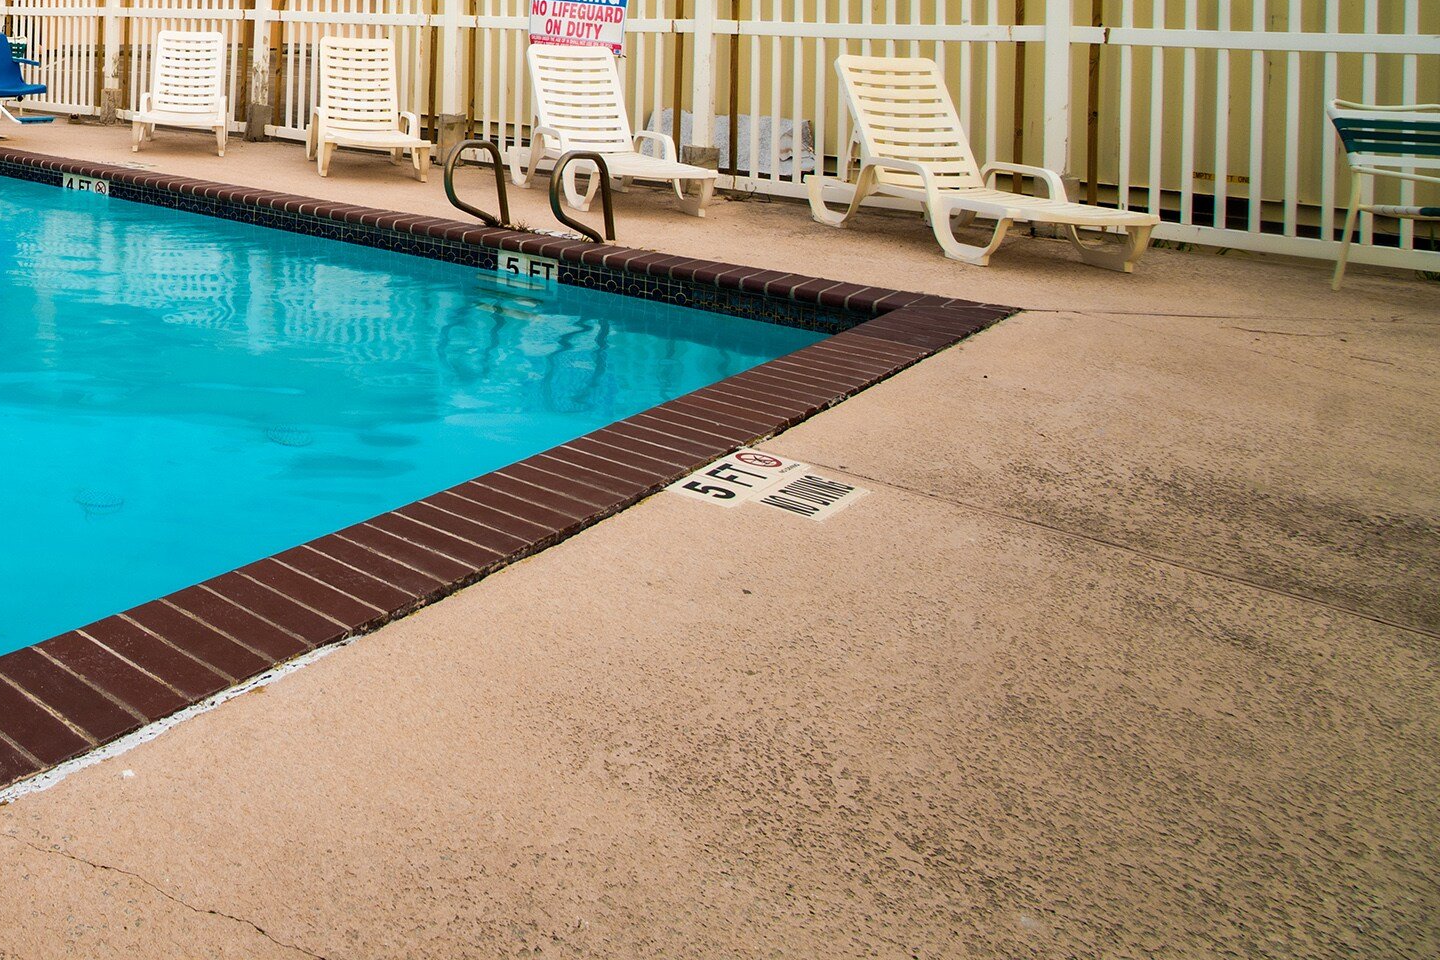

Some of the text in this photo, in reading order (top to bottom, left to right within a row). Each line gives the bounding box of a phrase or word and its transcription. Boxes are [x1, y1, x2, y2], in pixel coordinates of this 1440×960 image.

[532, 0, 623, 23] NO LIFEGUARD
[545, 19, 603, 40] ON DUTY
[79, 179, 92, 192] FT
[507, 257, 555, 280] 5 FT
[682, 463, 768, 499] 5 FT
[760, 475, 855, 517] NO DIVING
